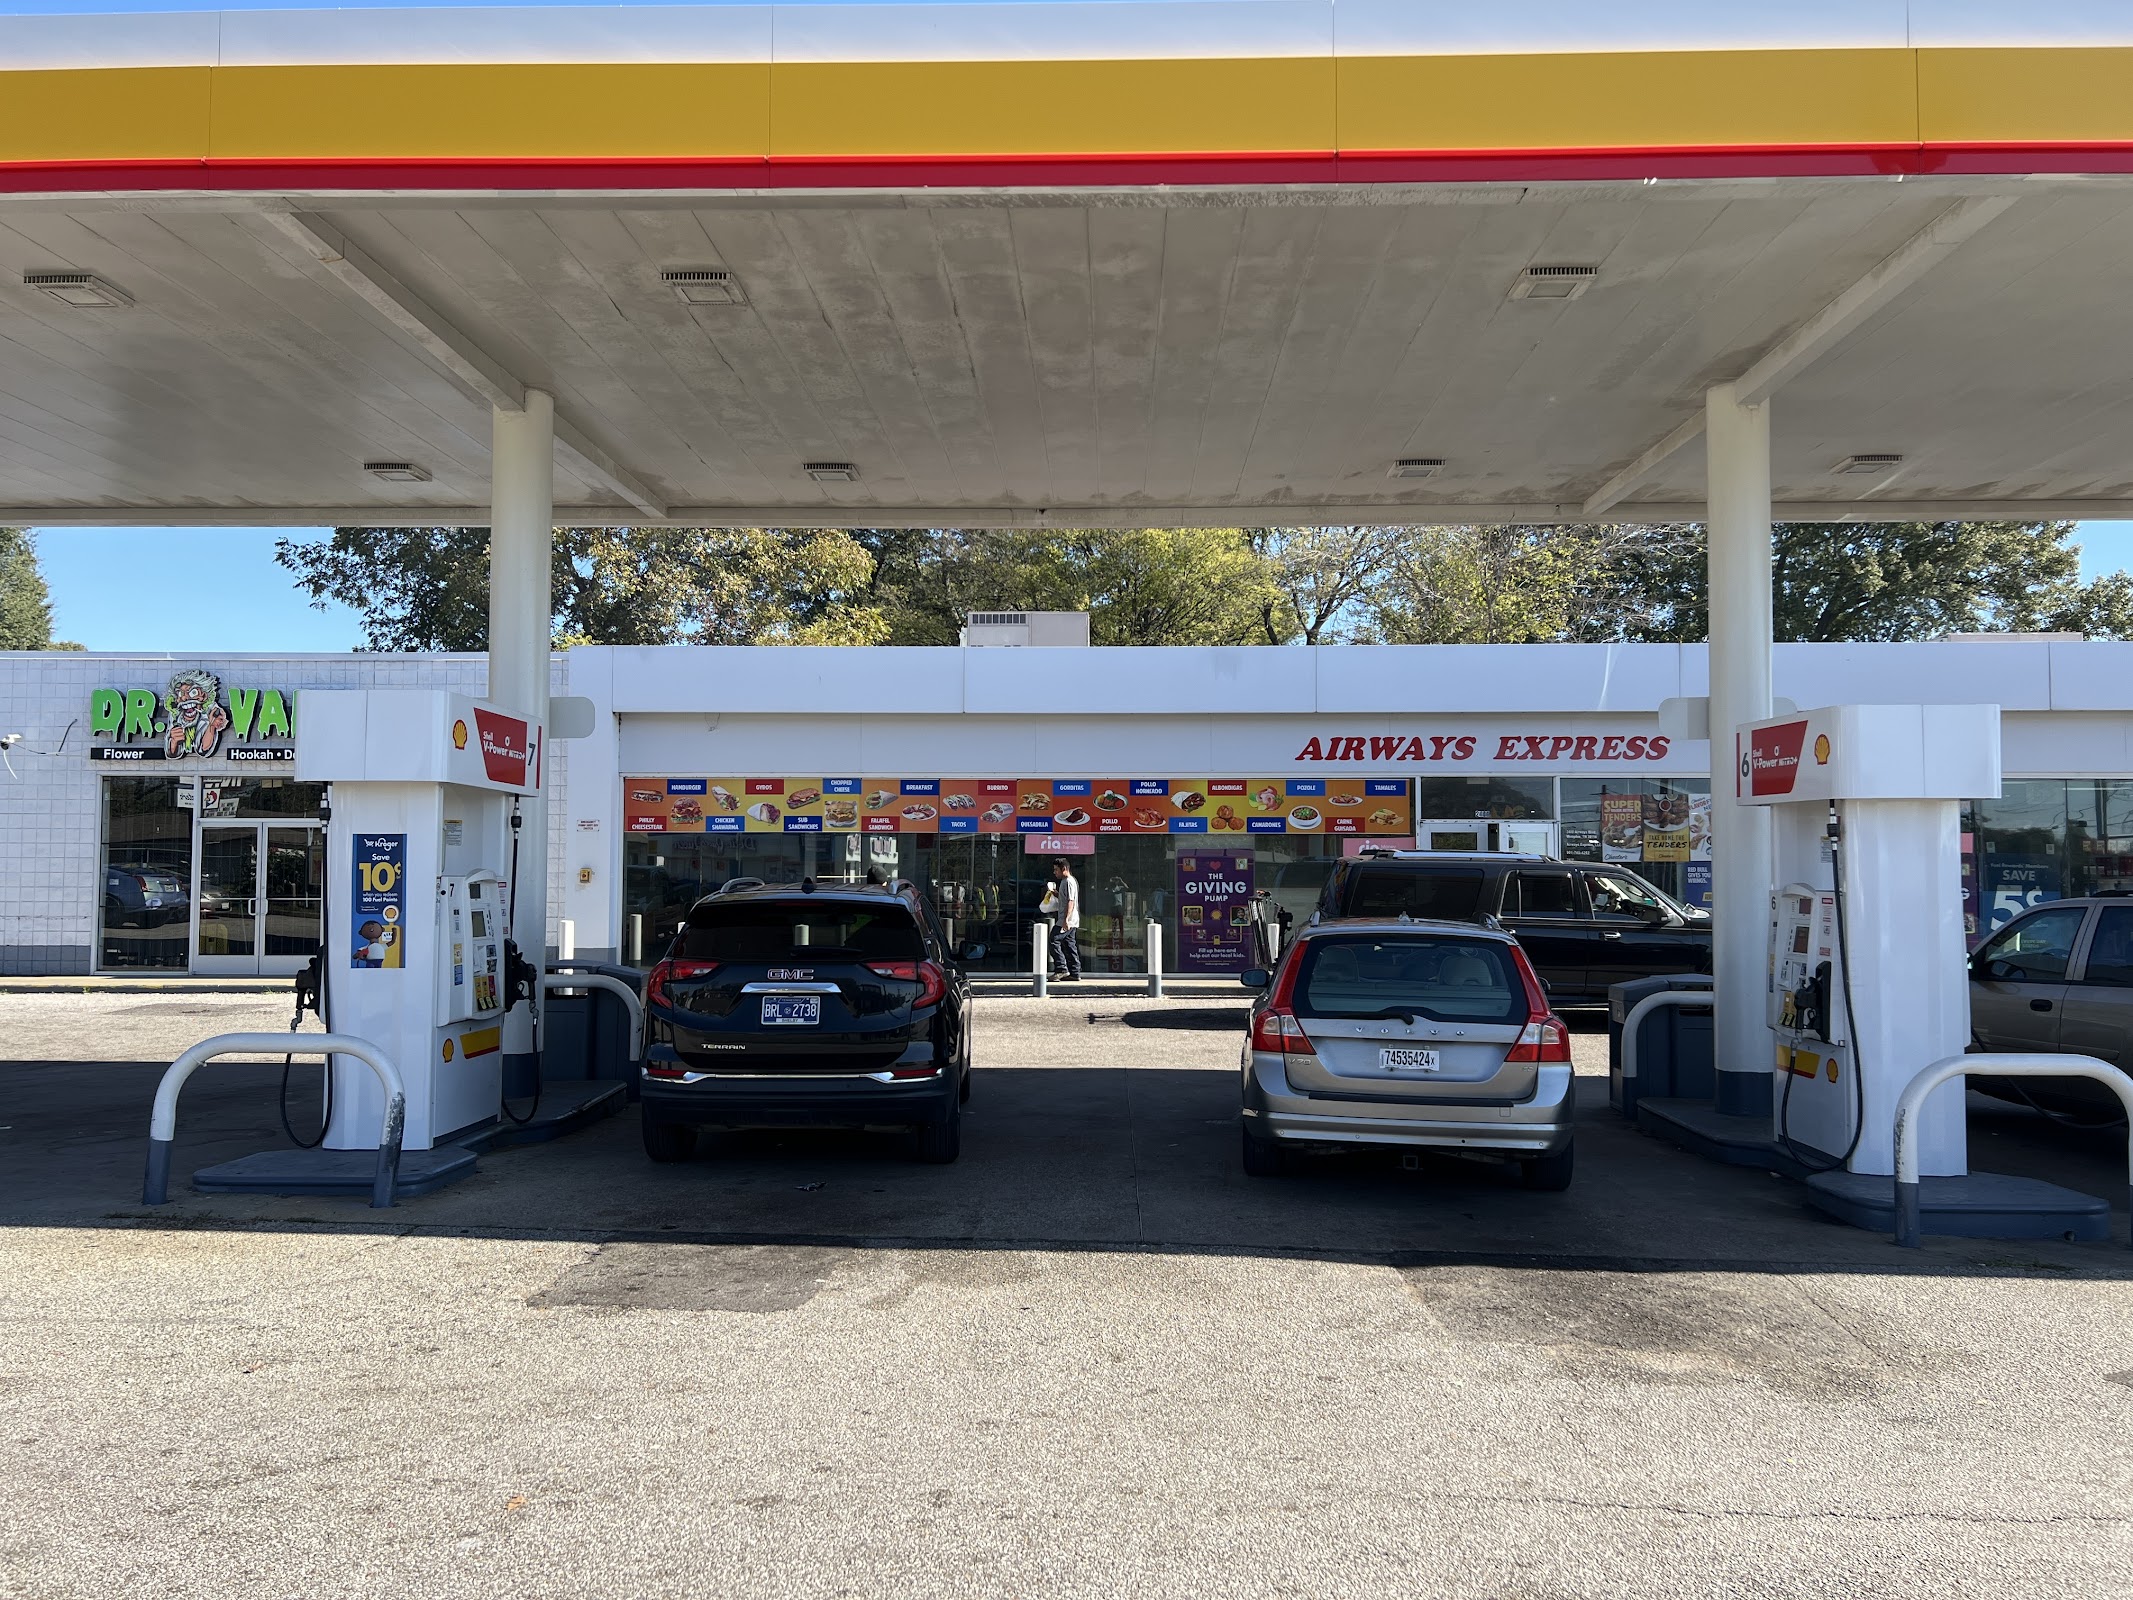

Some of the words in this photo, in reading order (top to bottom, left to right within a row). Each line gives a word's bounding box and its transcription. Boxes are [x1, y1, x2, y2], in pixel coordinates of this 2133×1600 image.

[91, 689, 166, 743] DR.
[228, 688, 295, 743] VA
[103, 748, 145, 760] Flower
[231, 749, 274, 760] Hookah
[528, 743, 536, 766] 7
[1295, 736, 1476, 761] AIRWAYS
[1494, 736, 1671, 761] EXPRESS
[1741, 752, 1750, 778] 6
[1604, 800, 1642, 813] SUPER
[1604, 813, 1642, 822] TENDERS
[375, 838, 398, 851] Kroger
[1040, 836, 1061, 850] ria
[1646, 841, 1688, 849] TENDERS
[372, 853, 390, 861] Save
[2002, 870, 2036, 881] SAVE
[1185, 881, 1247, 894] GIVING
[767, 969, 814, 980] GMC
[765, 1004, 782, 1017] BRL
[792, 1004, 817, 1017] 2738
